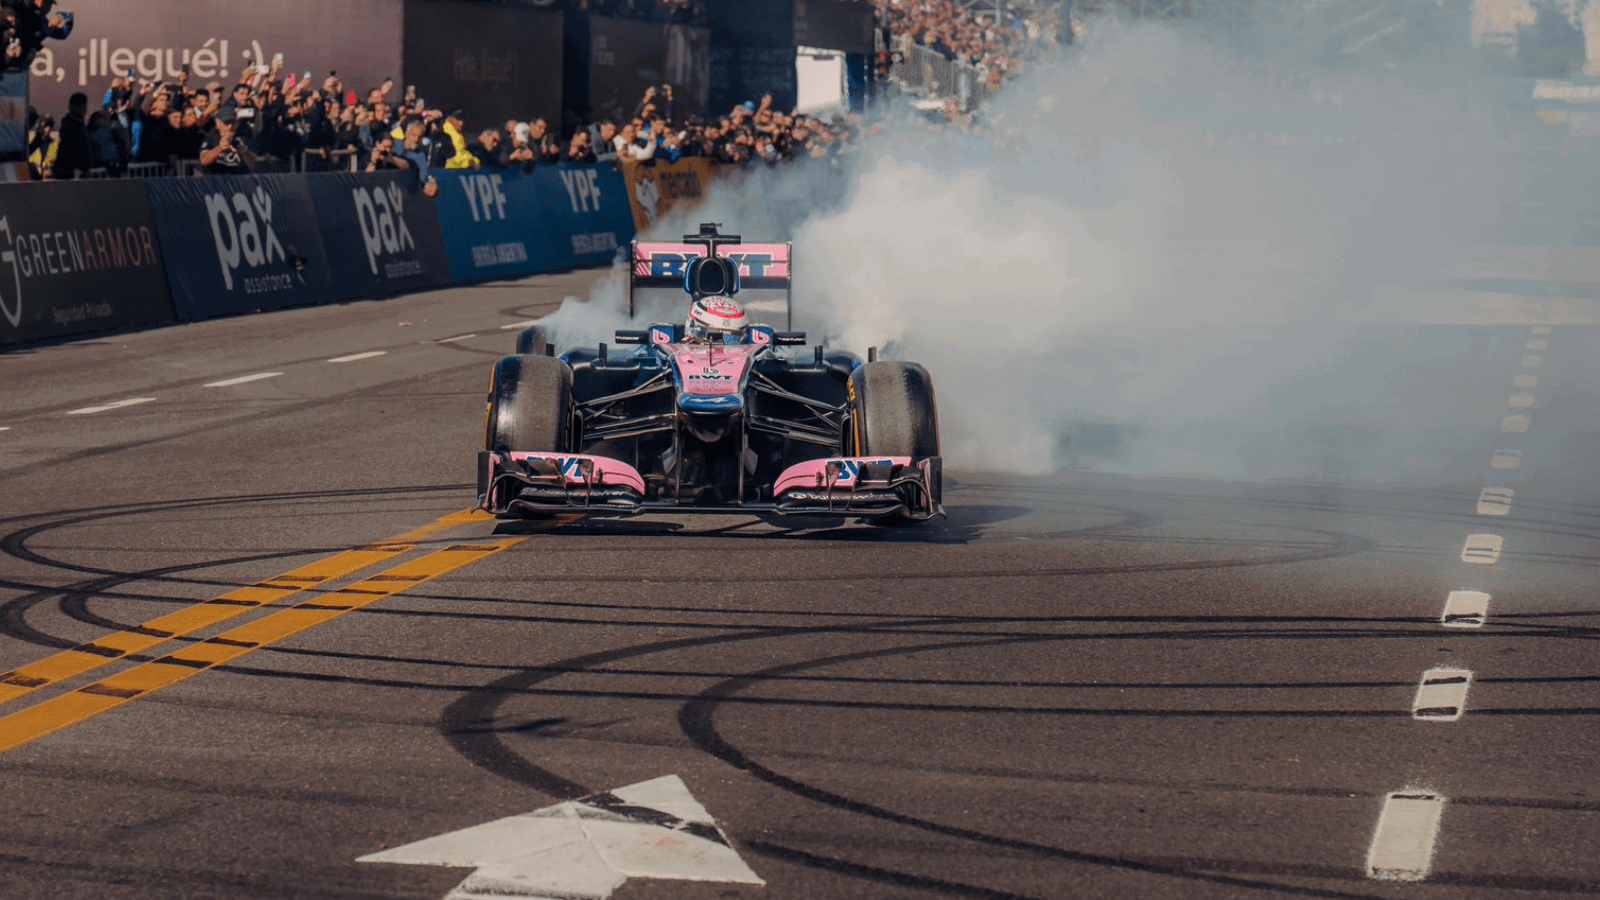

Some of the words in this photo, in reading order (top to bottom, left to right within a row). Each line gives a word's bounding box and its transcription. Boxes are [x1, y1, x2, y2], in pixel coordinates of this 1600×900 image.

[30, 47, 65, 83] a,
[78, 38, 228, 86] ¡llegué!
[459, 173, 507, 222] YPF
[559, 168, 601, 213] YPF
[16, 226, 157, 278] GREENARMOR
[204, 185, 286, 291] pax
[351, 181, 415, 275] pax
